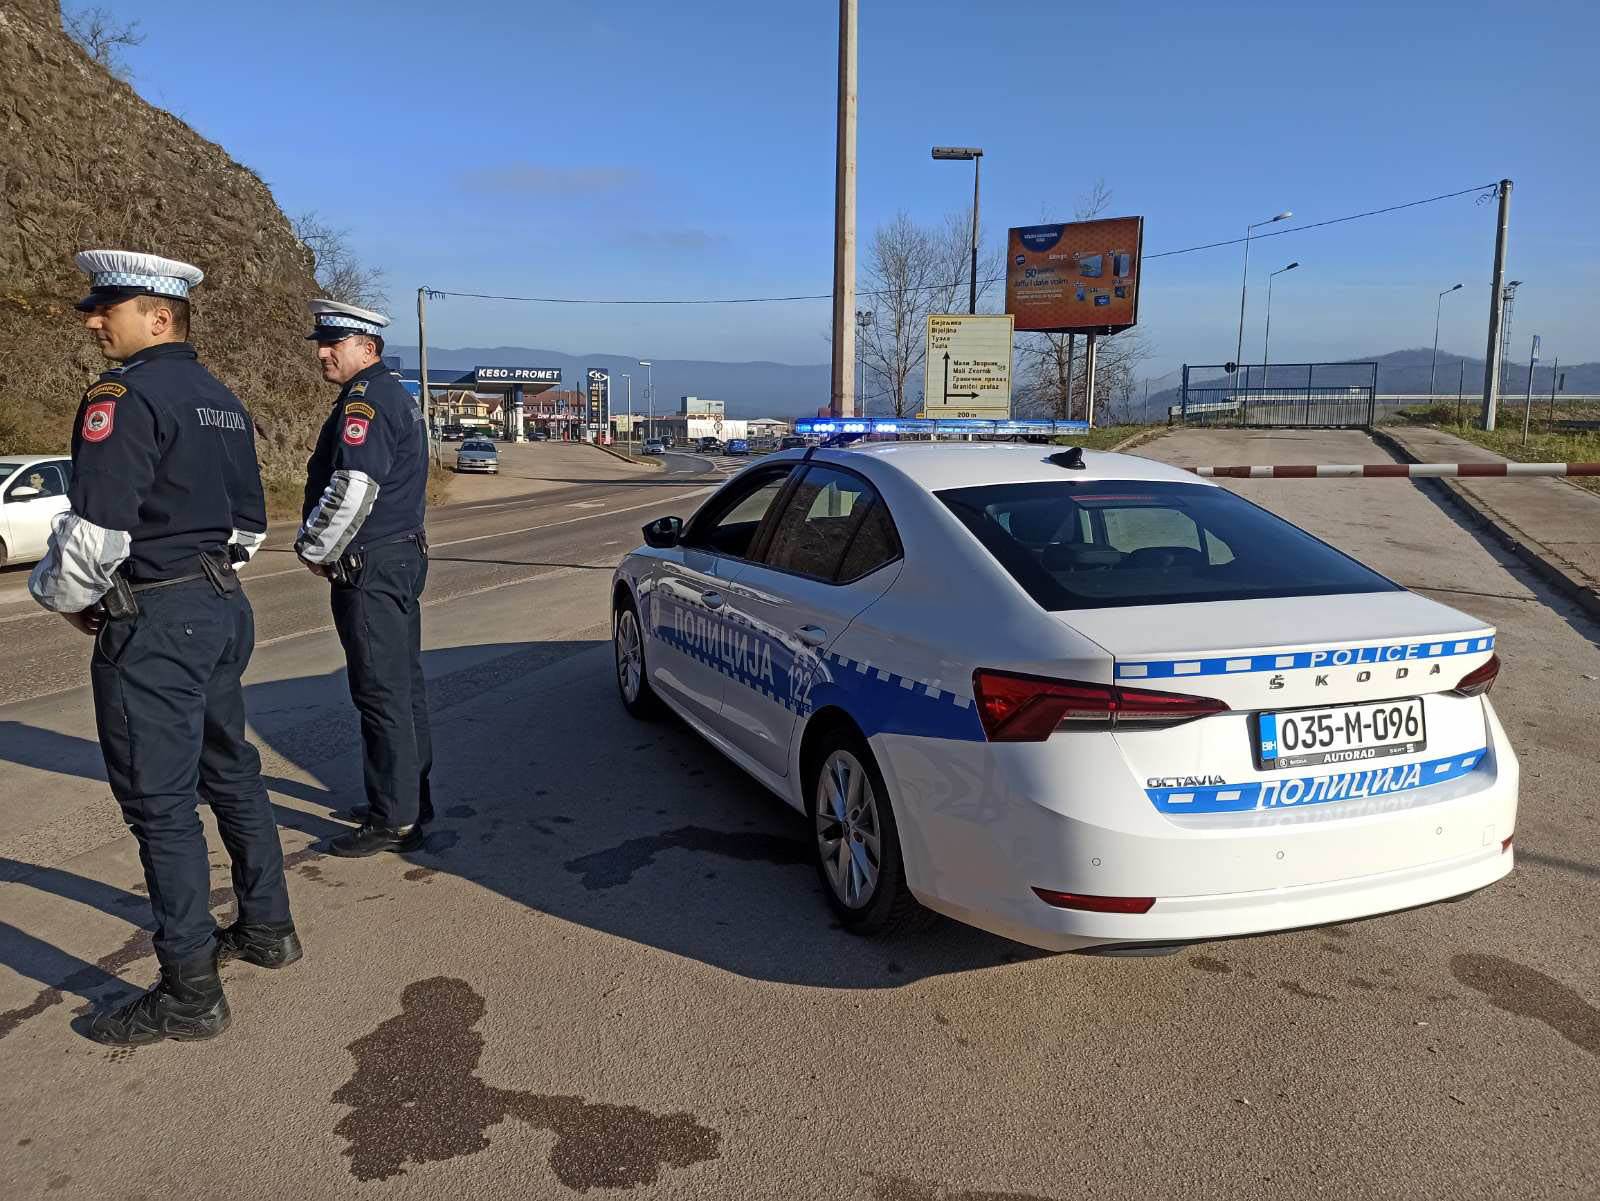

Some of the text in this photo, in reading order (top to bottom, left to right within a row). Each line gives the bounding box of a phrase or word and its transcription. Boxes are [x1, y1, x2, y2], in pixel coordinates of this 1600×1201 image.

[478, 368, 508, 378] KESO
[515, 369, 560, 379] PROMET
[674, 607, 775, 686] ПОЛИЦИЈА
[1309, 644, 1421, 668] POLICE
[787, 664, 812, 705] 122
[1269, 664, 1441, 690] ŠKODA
[1282, 705, 1419, 751] 035-M-096
[1262, 740, 1277, 751] BIH
[1323, 749, 1375, 764] AUTORAD
[1147, 775, 1226, 788] OCTAVIA
[1255, 764, 1421, 810] ПОЛИЦИЈА
